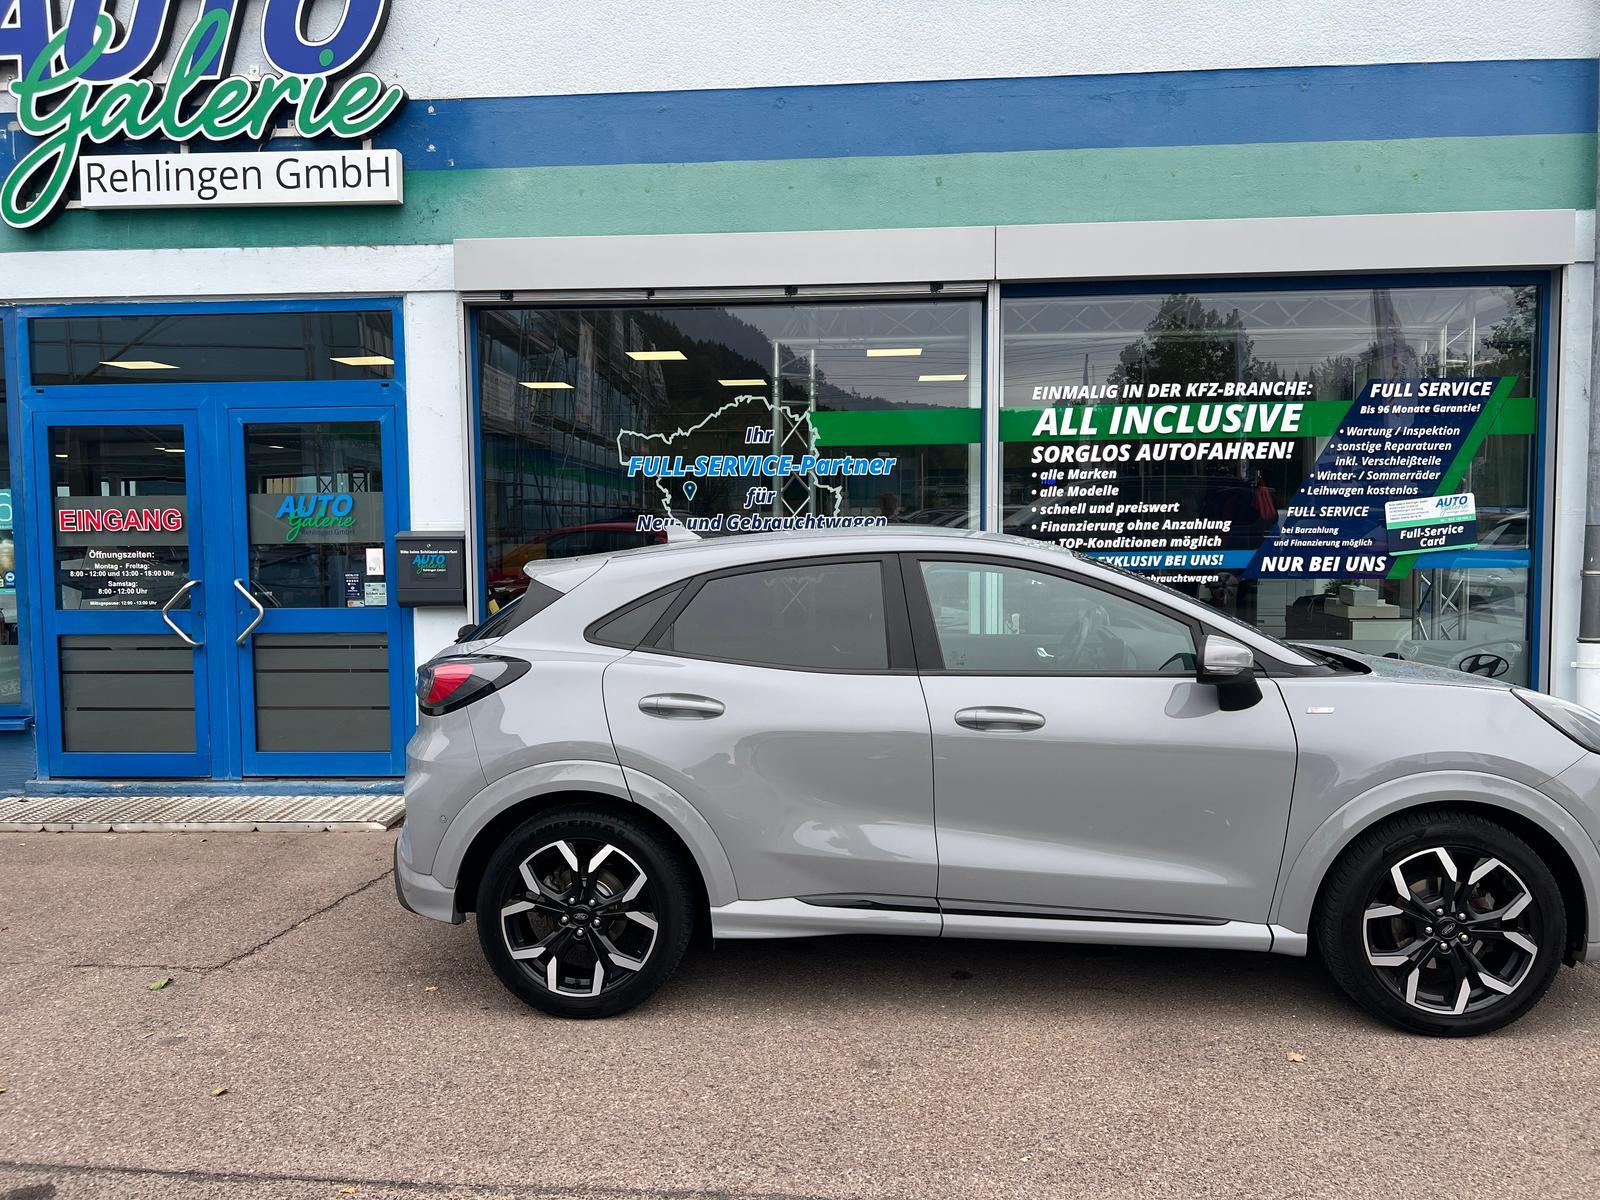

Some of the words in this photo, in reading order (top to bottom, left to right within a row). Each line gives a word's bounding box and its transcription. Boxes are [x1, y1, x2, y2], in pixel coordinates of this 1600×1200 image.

[0, 8, 406, 229] Galerie
[86, 159, 262, 200] Rehlingen
[275, 156, 391, 189] GmbH
[1032, 384, 1118, 400] EINMALIG
[1122, 384, 1144, 398] IN
[1147, 383, 1181, 398] DER
[1185, 381, 1313, 397] KFZ-BRANCHE:
[1370, 383, 1413, 398] FULL
[1418, 381, 1492, 397] SERVICE
[1360, 405, 1375, 414] Bis
[1377, 405, 1390, 414] 96
[1392, 404, 1430, 414] Monate
[1433, 403, 1481, 413] Garantie!
[1032, 406, 1098, 437] ALL
[1108, 403, 1303, 435] INCLUSIVE
[745, 425, 774, 444] Ihr
[1346, 426, 1393, 438] Wartung
[1402, 425, 1460, 438] Inspektion
[1031, 444, 1131, 464] SORGLOS
[1135, 441, 1295, 461] AUTOFAHREN!
[1337, 441, 1381, 453] sonstige
[1384, 441, 1452, 452] Reparaturen
[627, 454, 897, 477] FULL-SERVICE-Partner
[1335, 456, 1358, 466] inkl.
[1361, 455, 1442, 467] Verschleißteile
[1040, 469, 1064, 480] alle
[1067, 468, 1117, 480] Marken
[1317, 471, 1356, 481] Winter-
[1366, 470, 1441, 481] Sommerräder
[744, 487, 777, 509] für
[1040, 486, 1064, 498] alle
[1067, 485, 1119, 497] Modelle
[1307, 486, 1364, 498] Leihwagen
[1366, 485, 1418, 496] kostenlos
[277, 494, 353, 518] AUTO
[1436, 495, 1468, 508] AUTO
[1040, 503, 1086, 515] schnell
[1089, 503, 1114, 514] und
[1115, 501, 1180, 517] preiswert
[1287, 506, 1318, 517] FULL
[1319, 506, 1369, 517] SERVICE
[59, 508, 182, 532] EINGANG
[687, 514, 723, 531] und
[726, 514, 887, 532] Gebrauchtwagen
[1040, 520, 1124, 534] Finanzierung
[1127, 519, 1159, 531] ohne
[1162, 518, 1231, 533] Anzahlung
[1281, 526, 1293, 535] bei
[1295, 526, 1339, 536] Barzahlung
[1400, 524, 1464, 540] Full-Service
[1059, 536, 1168, 549] TOP-Konditionen
[1170, 535, 1222, 550] möglich
[1274, 539, 1288, 548] und
[1290, 538, 1340, 549] Finanzierung
[1342, 538, 1373, 549] möglich
[1420, 536, 1446, 547] Card
[89, 549, 154, 560] Öffnungszeiten:
[412, 554, 446, 565] AUTO
[1165, 555, 1186, 567] BEI
[1190, 554, 1224, 566] UNS!
[125, 562, 150, 570] Freitag:
[1261, 556, 1304, 573] NUR
[1308, 556, 1340, 572] BEI
[1345, 556, 1387, 572] UNS
[108, 580, 138, 588] Samstag:
